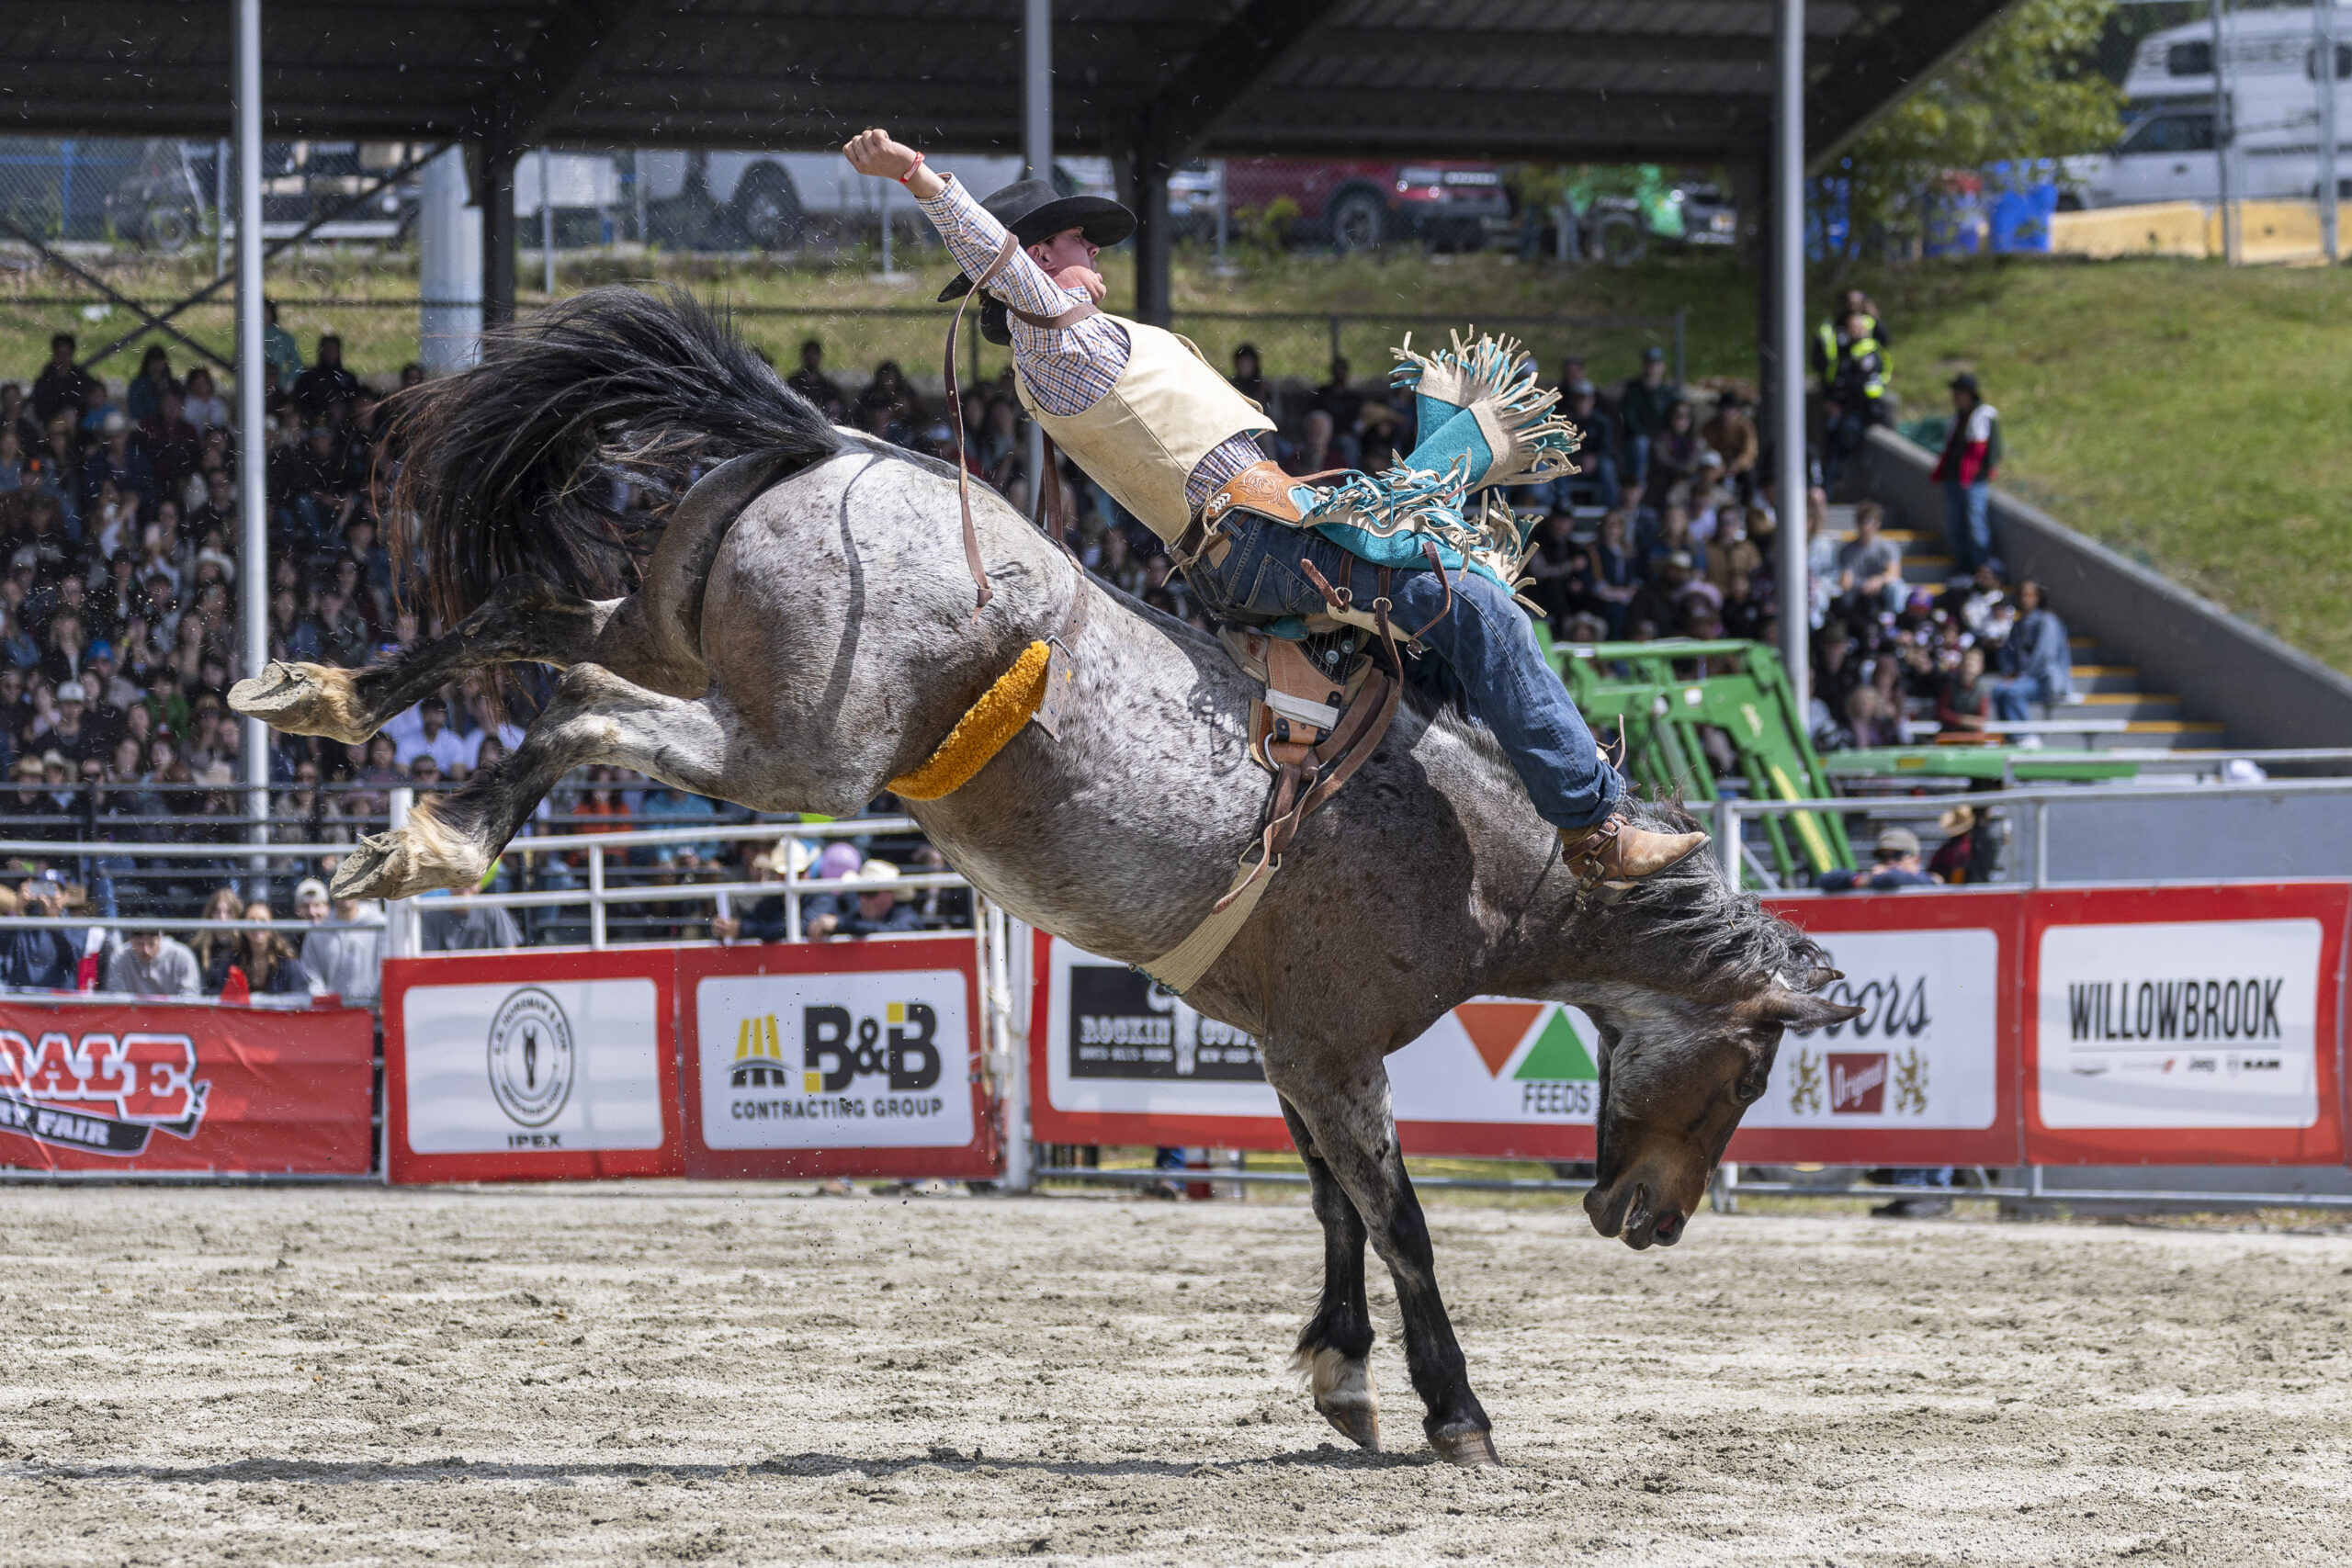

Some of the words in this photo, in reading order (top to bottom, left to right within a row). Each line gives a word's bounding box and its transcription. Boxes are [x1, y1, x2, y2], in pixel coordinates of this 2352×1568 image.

[1792, 951, 1931, 1039] oors
[2069, 977, 2283, 1041] WILLOWBROOK
[803, 1002, 941, 1093] B&B
[731, 1099, 866, 1120] CONTRACTING
[873, 1097, 944, 1118] GROUP
[1522, 1082, 1591, 1114] FEEDS
[37, 1109, 110, 1146] FAIR
[508, 1134, 562, 1148] IPEX
